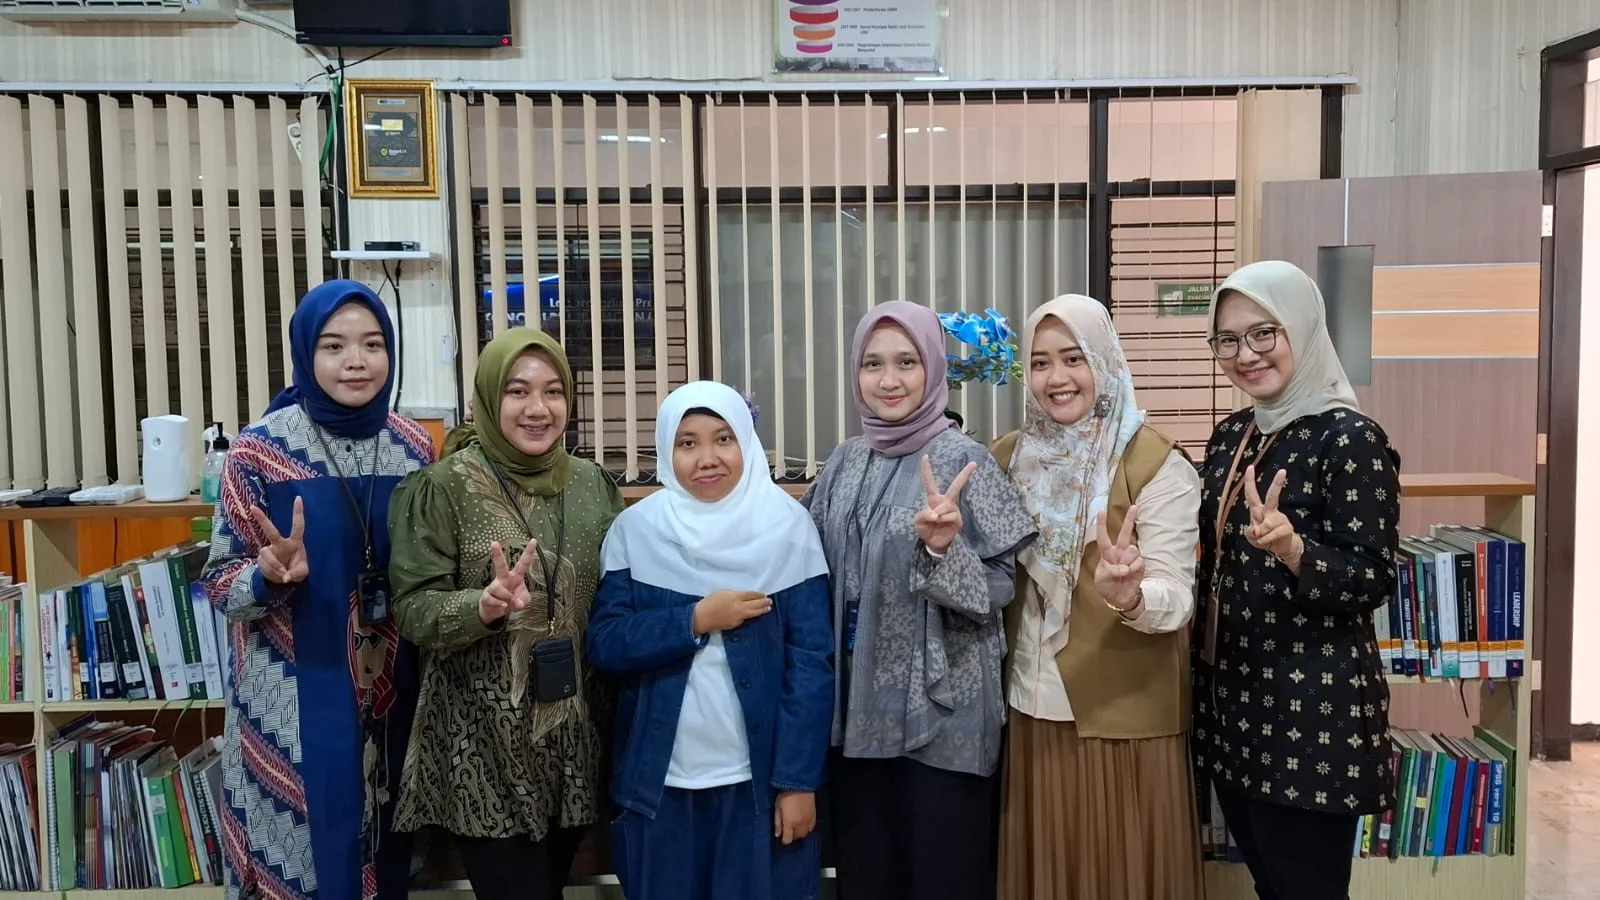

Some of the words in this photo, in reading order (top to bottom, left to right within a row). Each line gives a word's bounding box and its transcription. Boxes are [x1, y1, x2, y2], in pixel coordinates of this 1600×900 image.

[1513, 592, 1521, 628] LEADERSHIP
[1495, 764, 1503, 785] SPSS
[1493, 812, 1500, 822] 10
